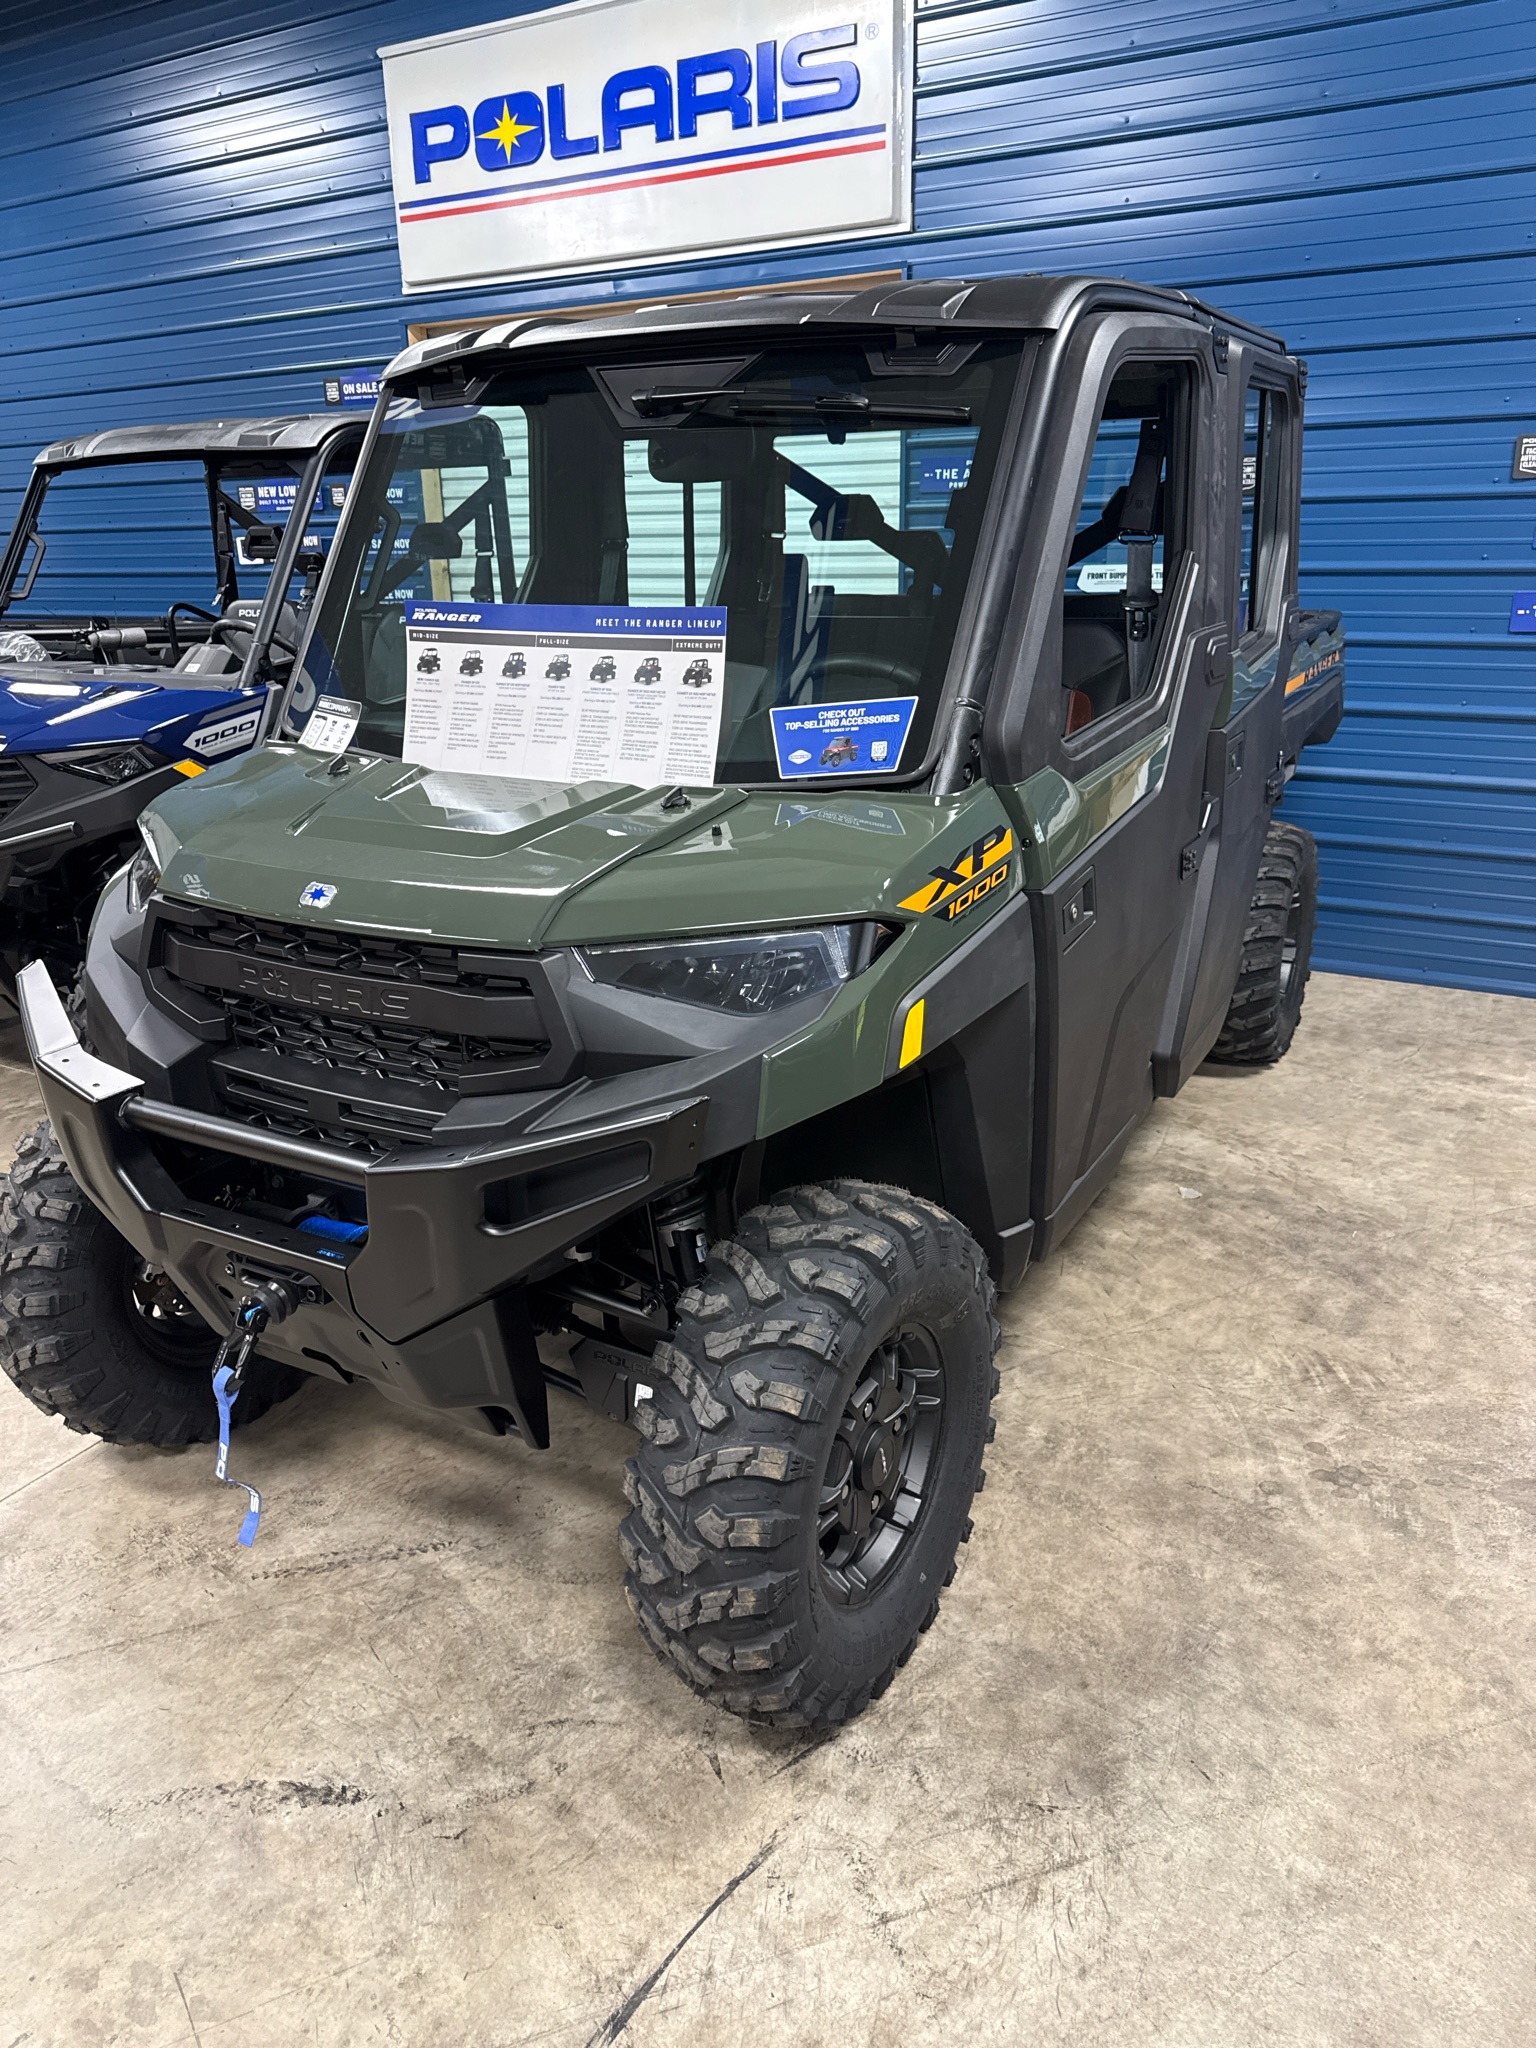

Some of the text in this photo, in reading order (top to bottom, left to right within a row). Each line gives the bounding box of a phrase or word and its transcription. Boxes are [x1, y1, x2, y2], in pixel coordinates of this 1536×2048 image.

[409, 23, 860, 184] POLARIS
[343, 384, 355, 394] ON
[356, 382, 378, 394] SALE
[935, 468, 958, 479] THE
[258, 485, 296, 498] NEW LOW
[303, 536, 318, 546] NOW
[395, 590, 413, 599] NOW
[412, 612, 482, 623] RANGER
[595, 618, 722, 628] MEET THE RANGER LINEUP
[818, 708, 866, 719] CHECK OUT
[785, 714, 900, 731] TOP-SELLING ACCESSORIES
[194, 720, 256, 748] 1000
[949, 864, 1008, 919] 1000
[239, 961, 411, 1019] POLARIS
[594, 1350, 660, 1378] POLAR
